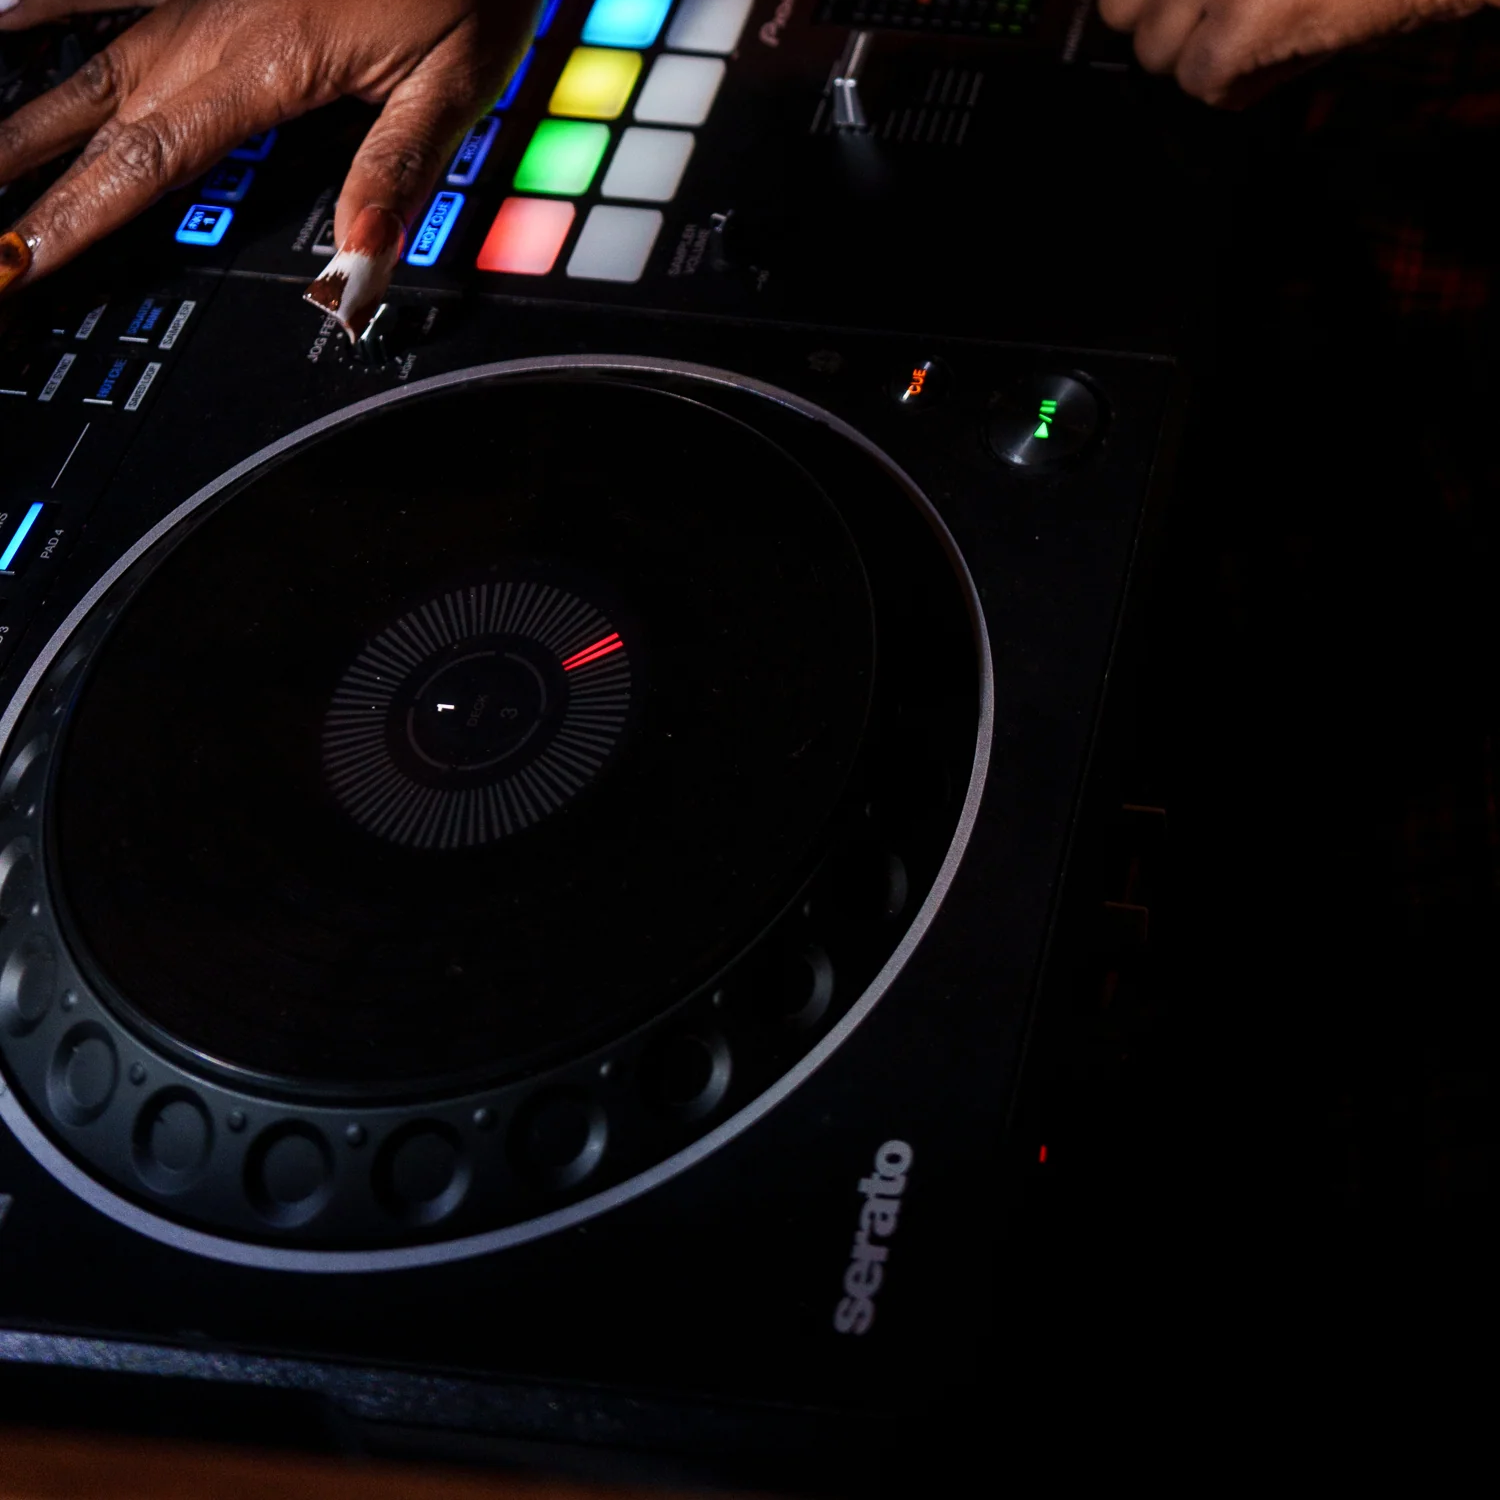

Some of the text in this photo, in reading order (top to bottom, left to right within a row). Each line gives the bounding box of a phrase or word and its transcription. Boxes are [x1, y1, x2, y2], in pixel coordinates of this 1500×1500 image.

[418, 198, 450, 251] HOT CUE
[162, 302, 192, 347] SAMPLER
[306, 335, 326, 364] JOG
[398, 353, 417, 380] LIGHT
[908, 368, 927, 396] CUE
[40, 537, 59, 559] PAD
[436, 702, 455, 713] 1
[466, 694, 488, 728] DECK
[499, 706, 519, 720] 3
[832, 1138, 914, 1337] serato
